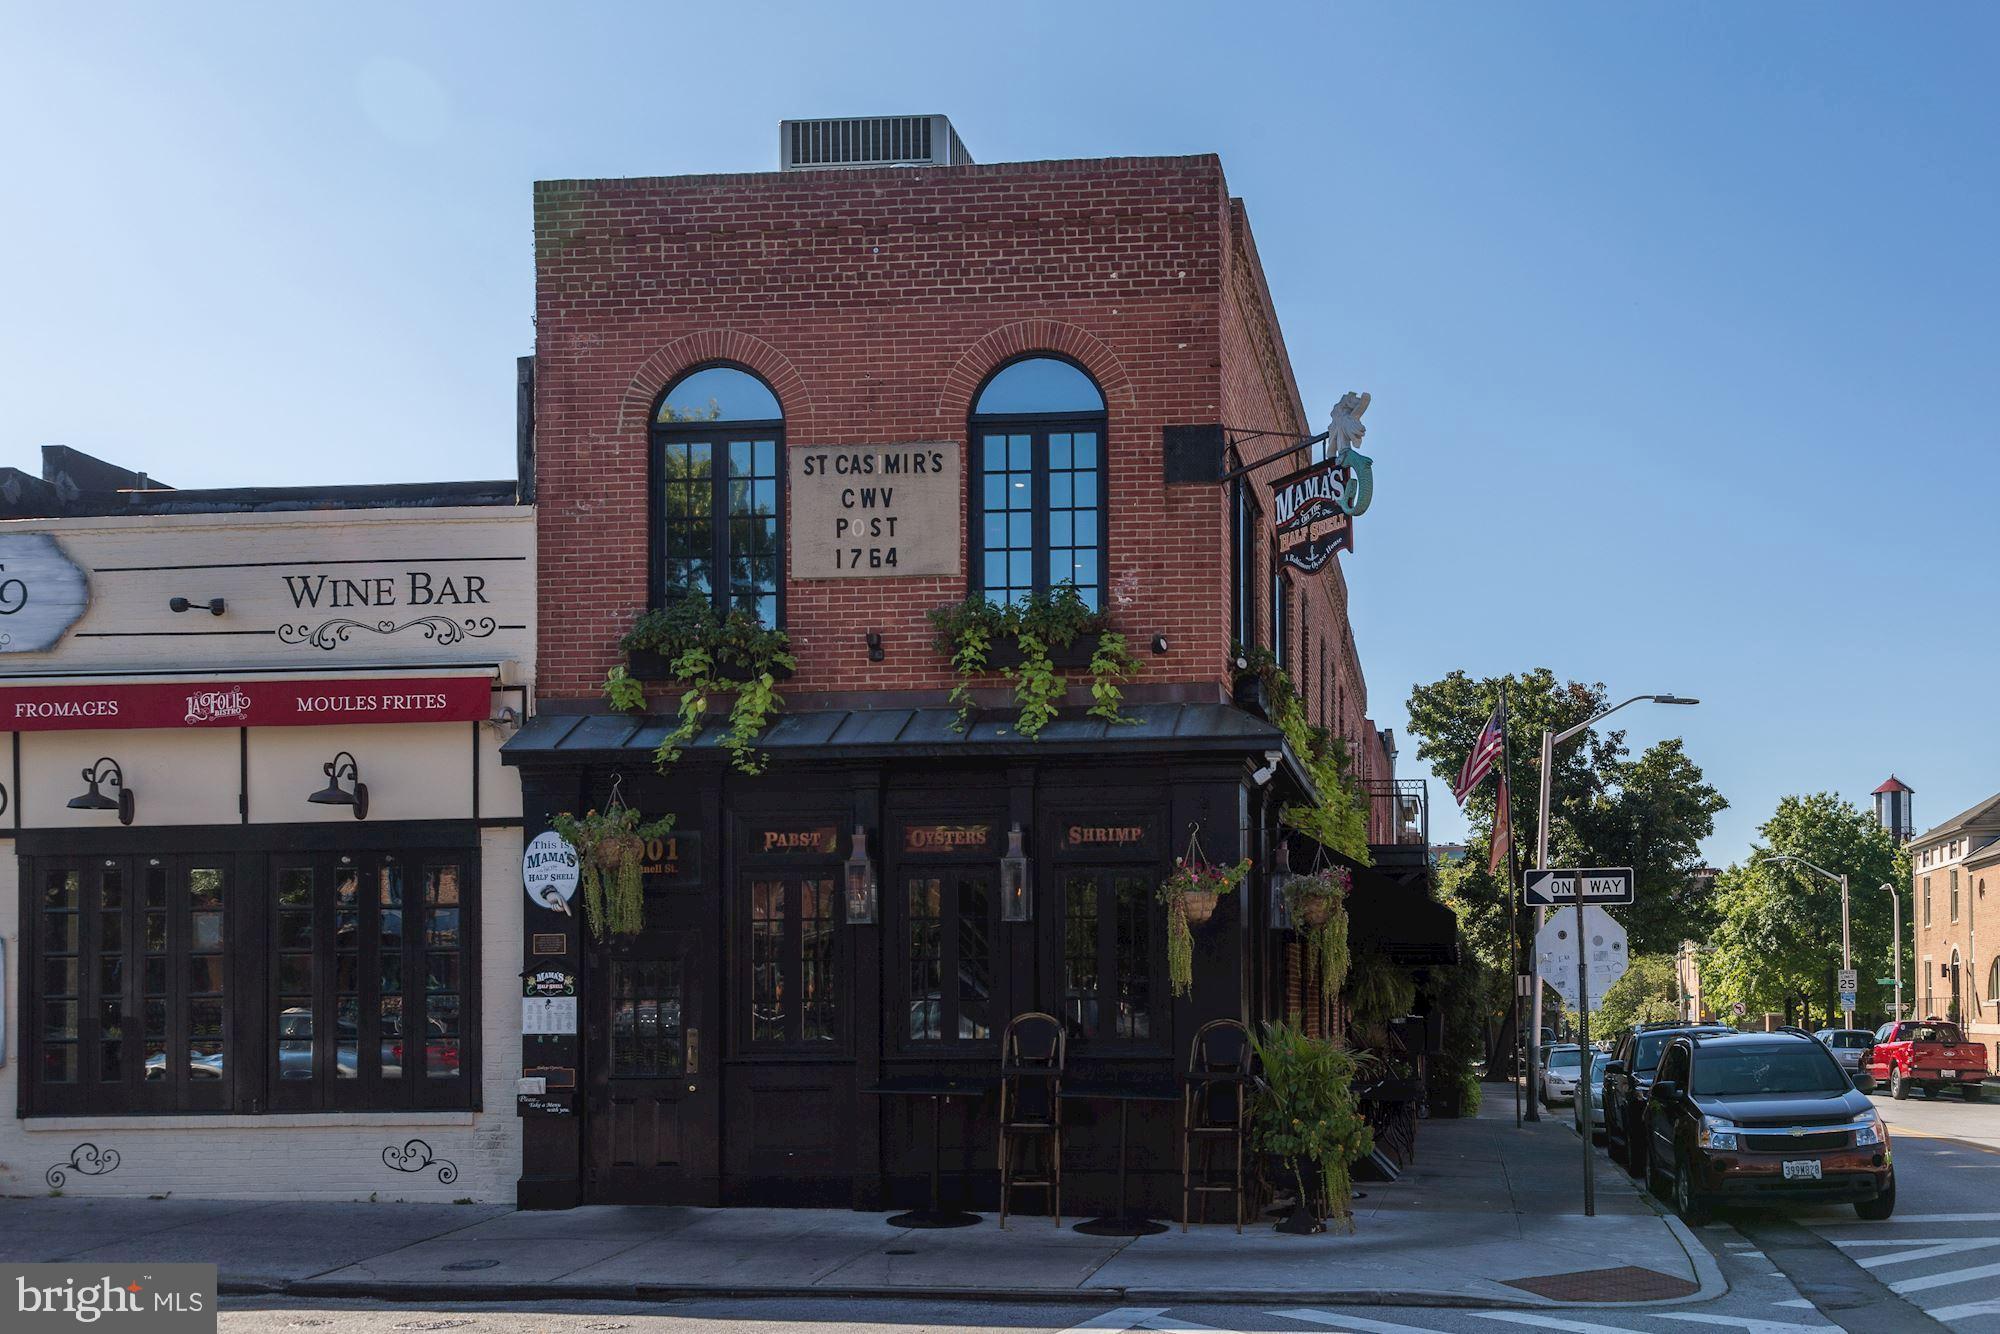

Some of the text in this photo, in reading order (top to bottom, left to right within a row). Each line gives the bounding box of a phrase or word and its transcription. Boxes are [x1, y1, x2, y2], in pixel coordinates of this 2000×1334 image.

[803, 450, 943, 475] ST CASIMIR'S
[841, 487, 893, 508] CWV
[1275, 467, 1345, 525] MAMA'S
[836, 517, 898, 538] POST
[1279, 513, 1347, 552] HALF SHELL
[836, 547, 897, 568] 1764
[282, 572, 490, 609] WINE BAR
[15, 701, 119, 718] FROMAGES
[200, 691, 251, 714] FOLIE
[214, 707, 242, 717] BISTRO
[297, 693, 447, 712] MOULES FRITES
[764, 831, 821, 849] PABST
[911, 829, 987, 848] OYSTERS
[1069, 826, 1142, 844] SHRIMP
[533, 841, 557, 849] This
[527, 851, 576, 868] MAMA'S
[529, 873, 575, 882] HALF SHELL
[1590, 880, 1622, 893] WAY
[1840, 979, 1855, 989] 25
